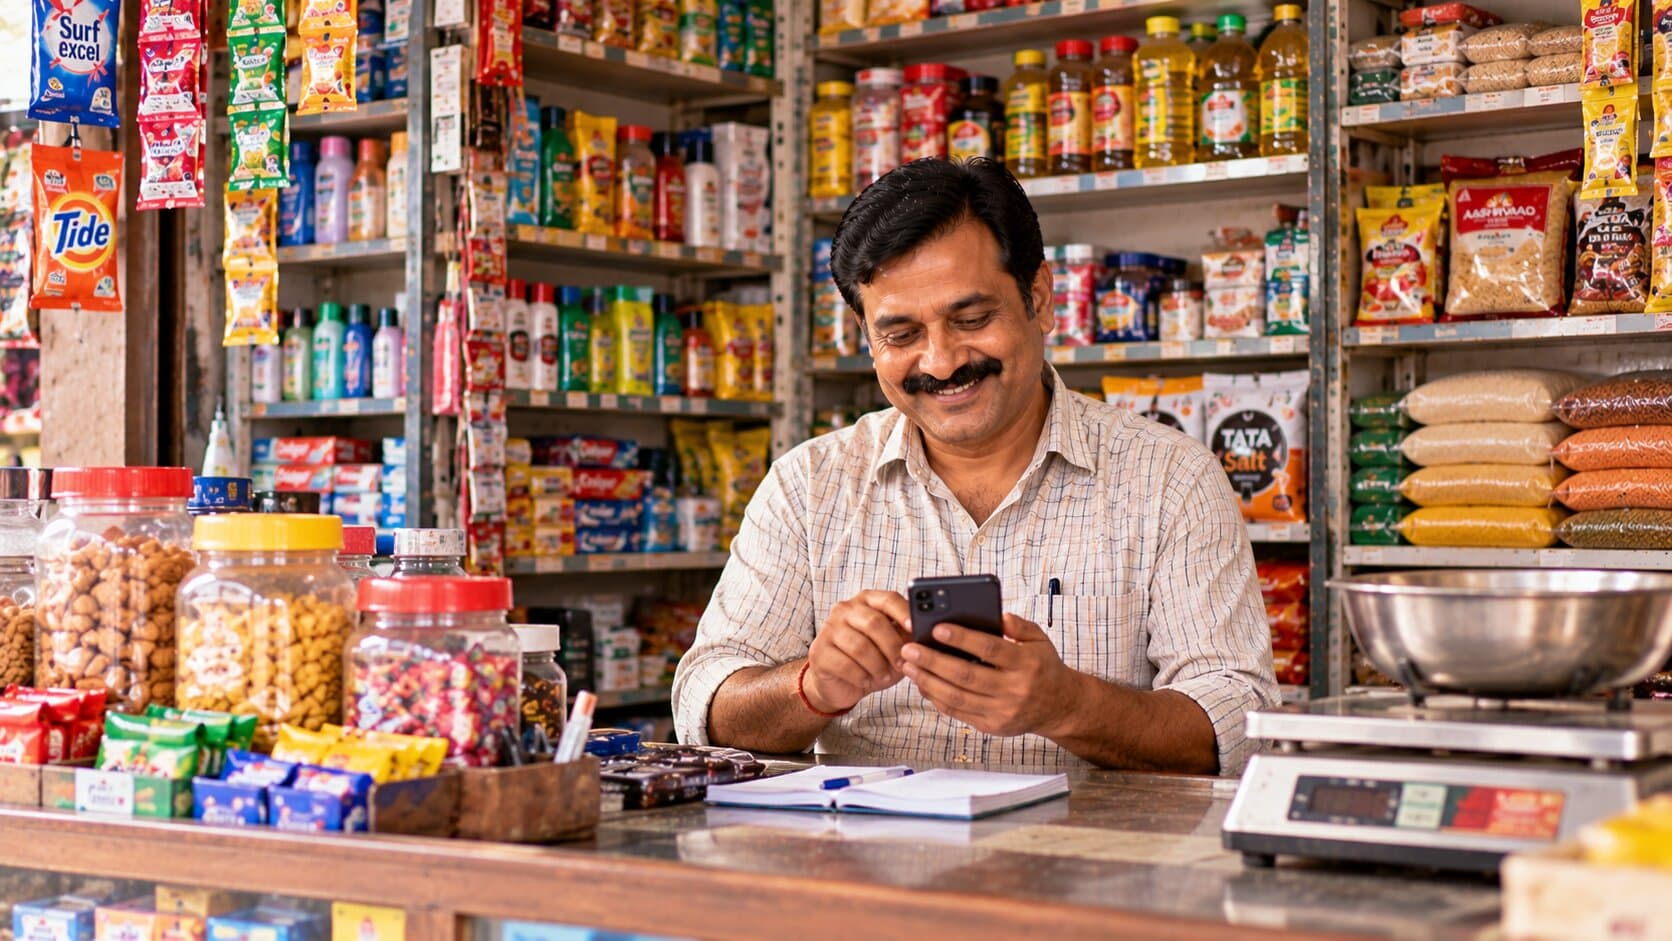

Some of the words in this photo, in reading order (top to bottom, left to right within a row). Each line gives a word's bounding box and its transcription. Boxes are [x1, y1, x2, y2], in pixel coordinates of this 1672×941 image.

[59, 16, 101, 43] Surf
[59, 41, 100, 62] excel
[53, 210, 110, 255] Tide
[1221, 428, 1273, 448] TATA
[1224, 450, 1267, 472] Salt
